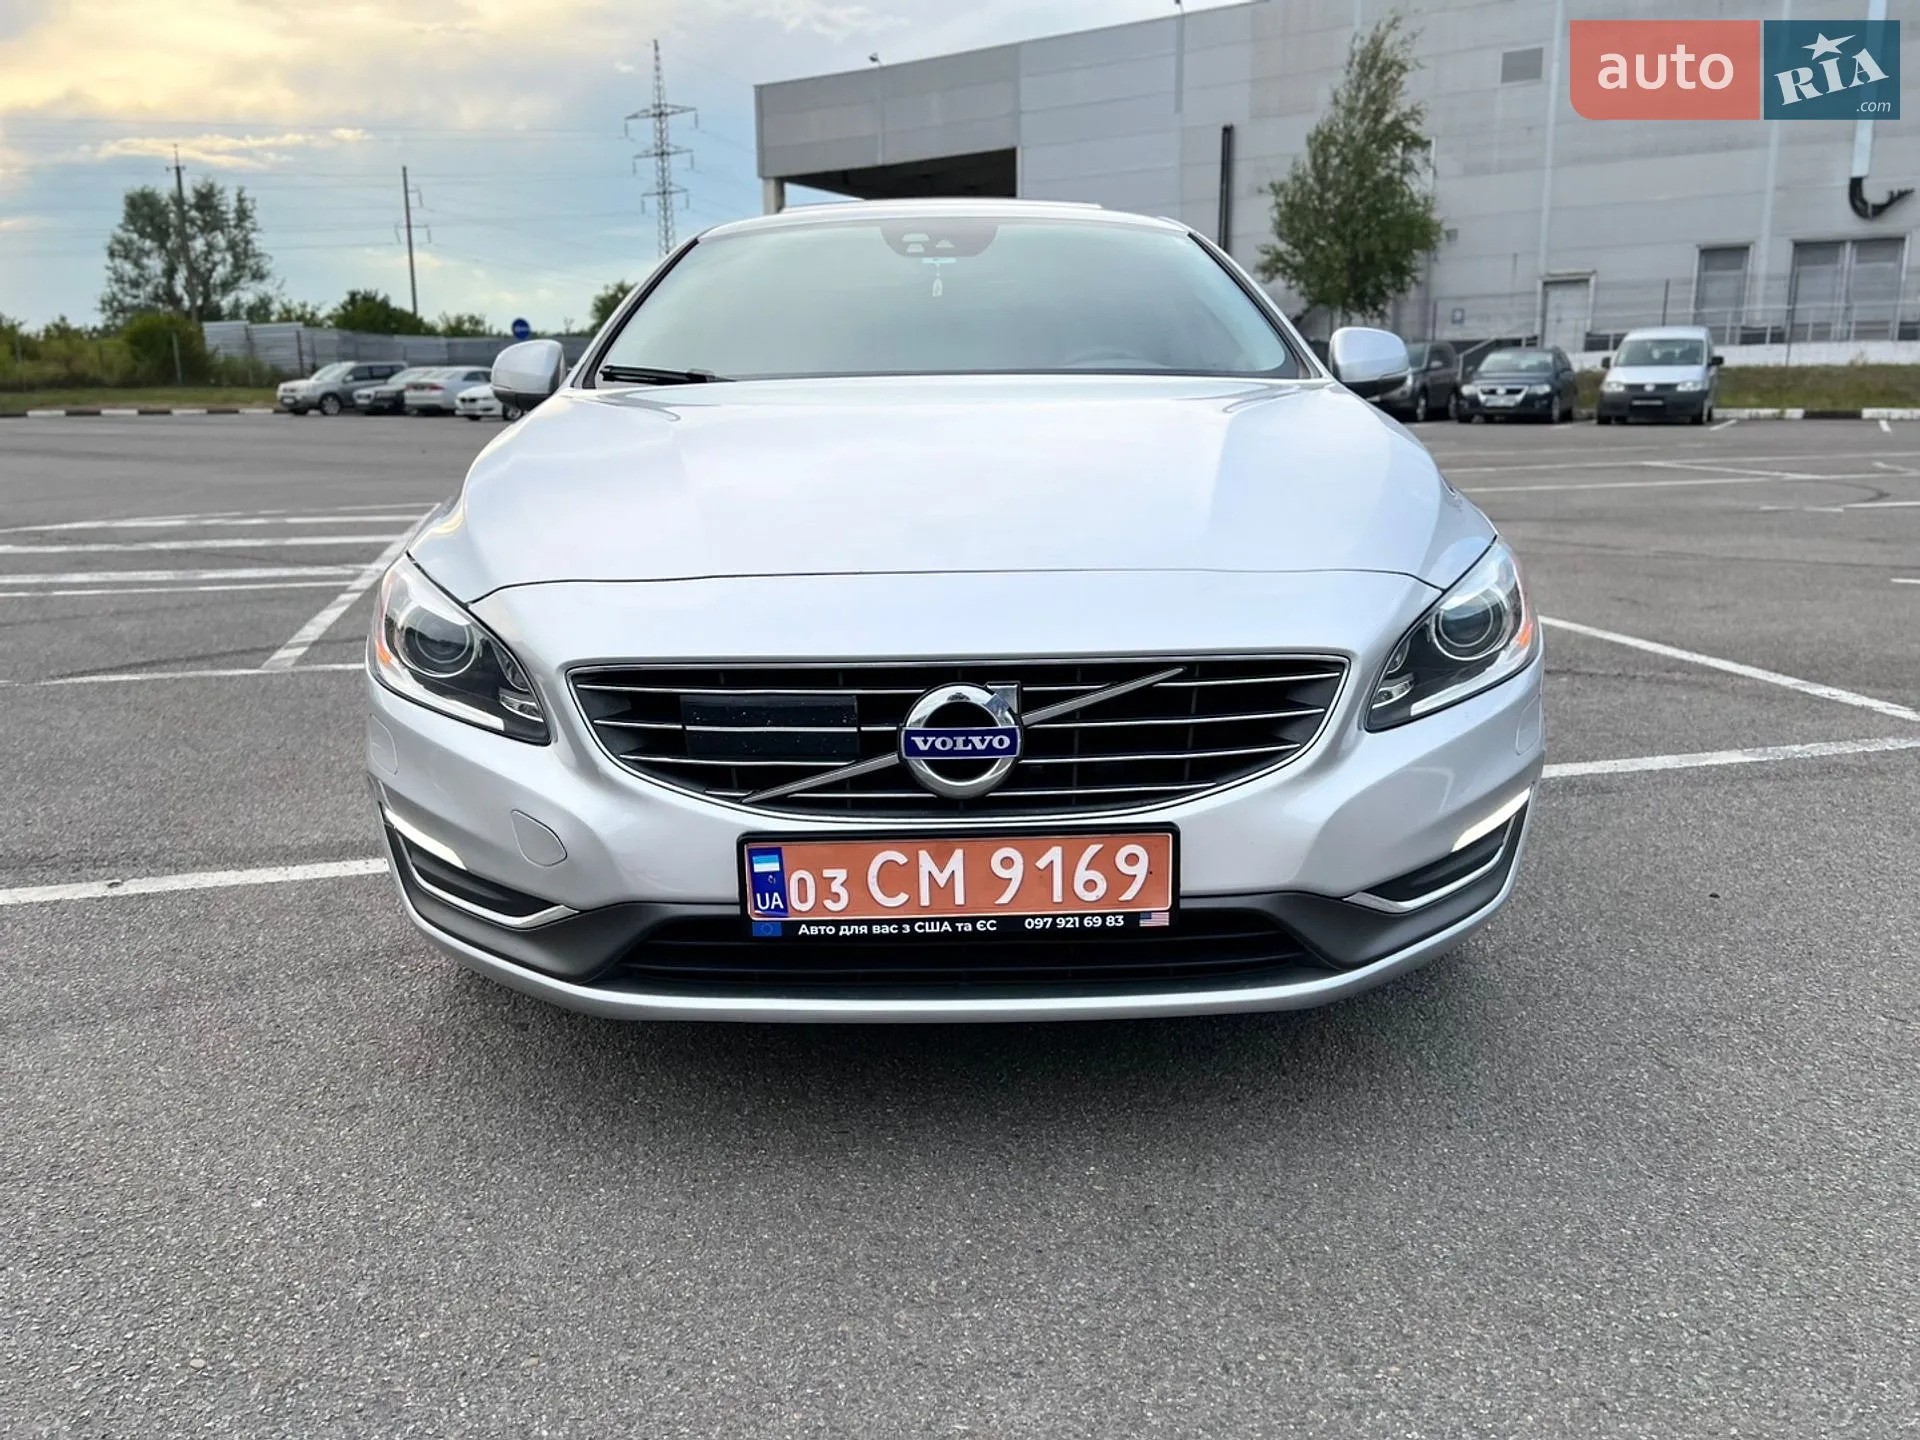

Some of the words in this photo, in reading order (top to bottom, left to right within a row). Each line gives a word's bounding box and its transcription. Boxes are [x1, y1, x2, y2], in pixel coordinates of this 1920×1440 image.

[910, 734, 1011, 751] VOLVO
[788, 868, 850, 912] 03
[866, 848, 965, 908] CM
[989, 843, 1151, 905] 9169
[755, 891, 785, 911] UA
[798, 924, 836, 936] Авто
[839, 926, 868, 937] для
[872, 924, 899, 934] вас
[902, 924, 911, 934] з
[914, 921, 952, 933] США
[955, 922, 973, 932] та
[976, 920, 997, 931] ЄС
[1024, 918, 1053, 930] 097
[1056, 916, 1080, 929] 921
[1083, 915, 1103, 928] 69
[1105, 915, 1125, 927] 83
